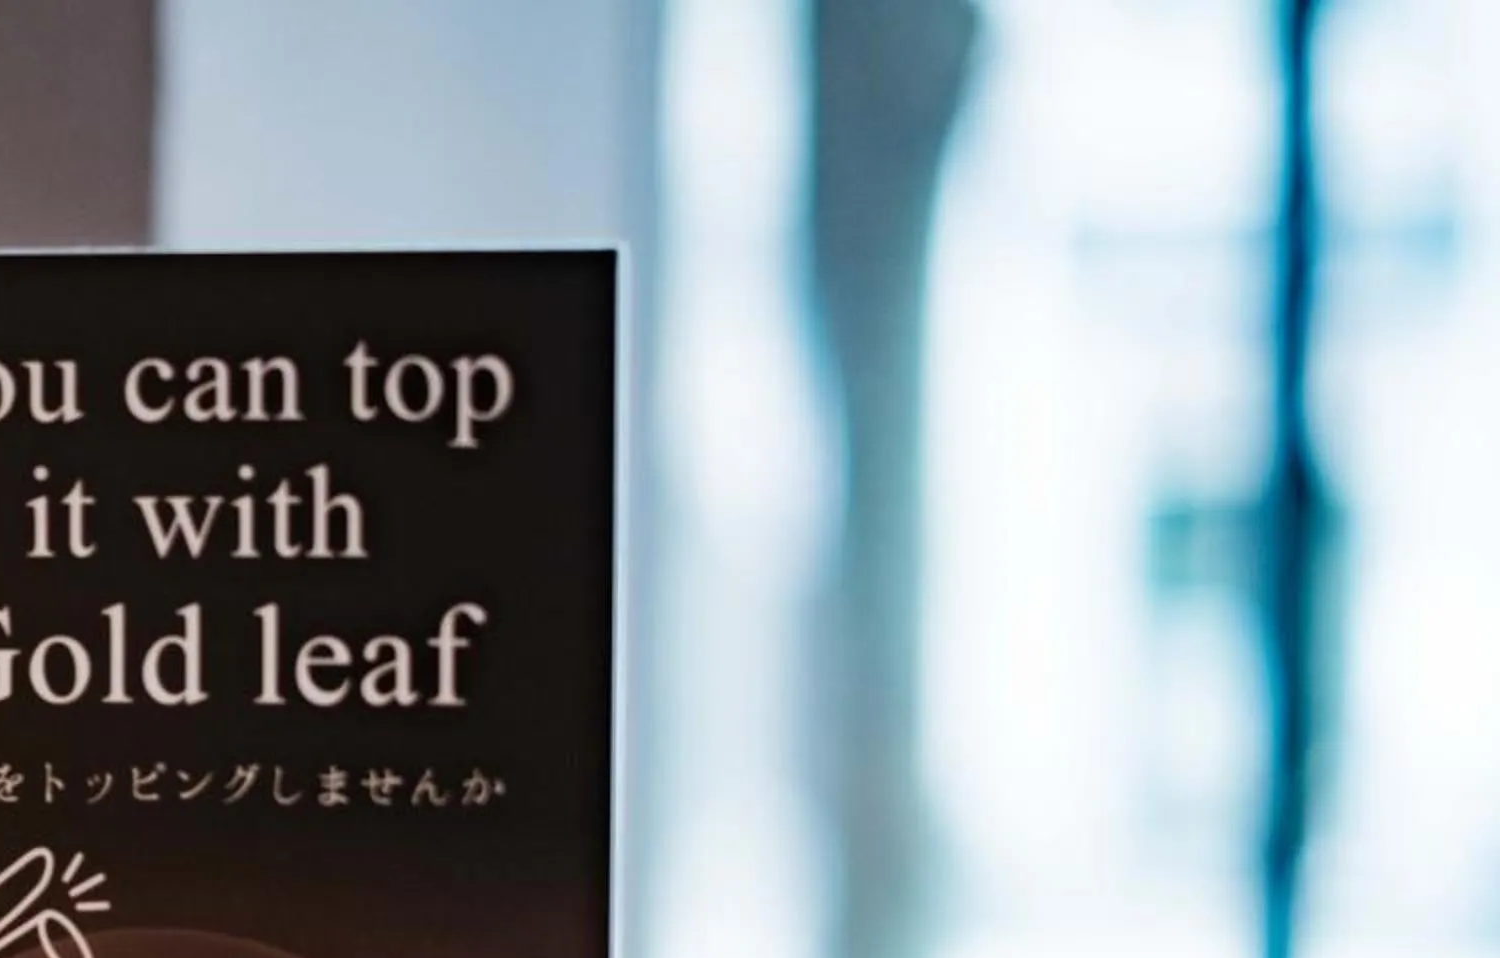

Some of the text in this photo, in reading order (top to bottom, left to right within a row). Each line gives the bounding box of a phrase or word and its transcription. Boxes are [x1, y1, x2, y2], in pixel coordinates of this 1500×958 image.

[125, 357, 302, 422] can
[345, 343, 512, 447] top
[27, 464, 366, 558] it with
[254, 603, 486, 706] leaf
